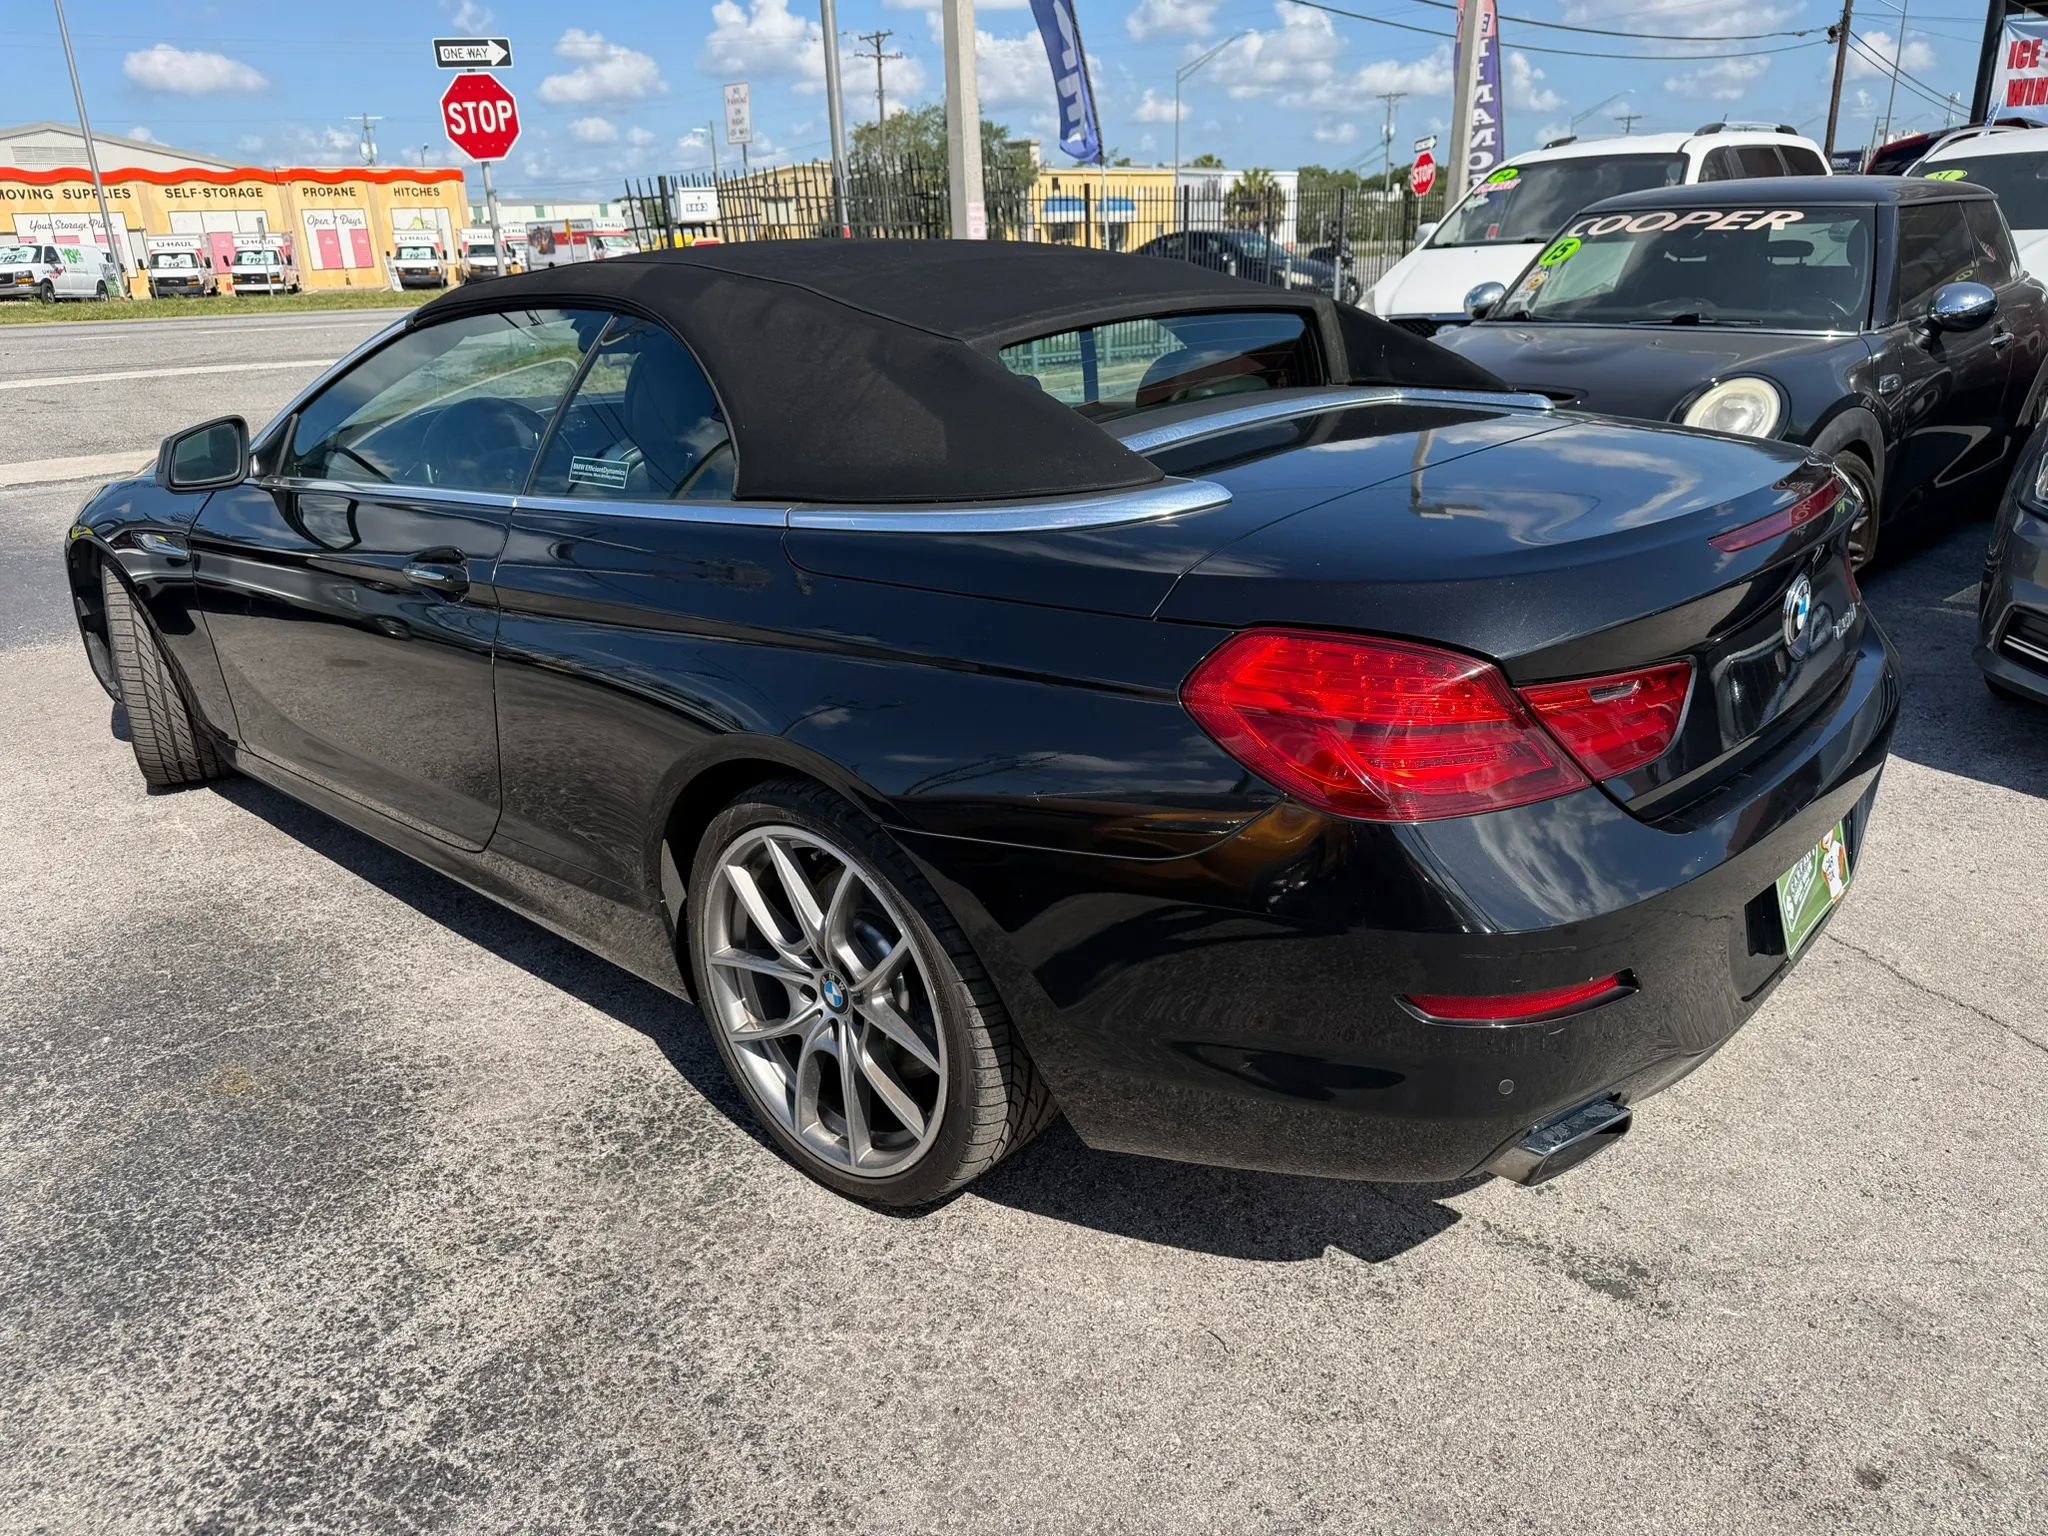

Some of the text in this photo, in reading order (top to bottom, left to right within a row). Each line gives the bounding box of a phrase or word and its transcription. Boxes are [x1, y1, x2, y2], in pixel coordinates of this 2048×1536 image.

[443, 47, 488, 59] ONE WAY
[2007, 39, 2042, 69] ICE
[447, 100, 513, 135] STOP
[1412, 163, 1434, 185] STOP
[165, 187, 264, 198] SELF-STORAGE
[303, 187, 357, 197] PROPANE
[393, 187, 441, 197] HITCHES
[29, 219, 52, 232] Your
[306, 214, 330, 228] Open
[340, 214, 363, 226] Days
[1567, 210, 1804, 239] COOPER
[1543, 241, 1576, 262] 15
[573, 463, 585, 471] BMW
[821, 972, 847, 991] BMW
